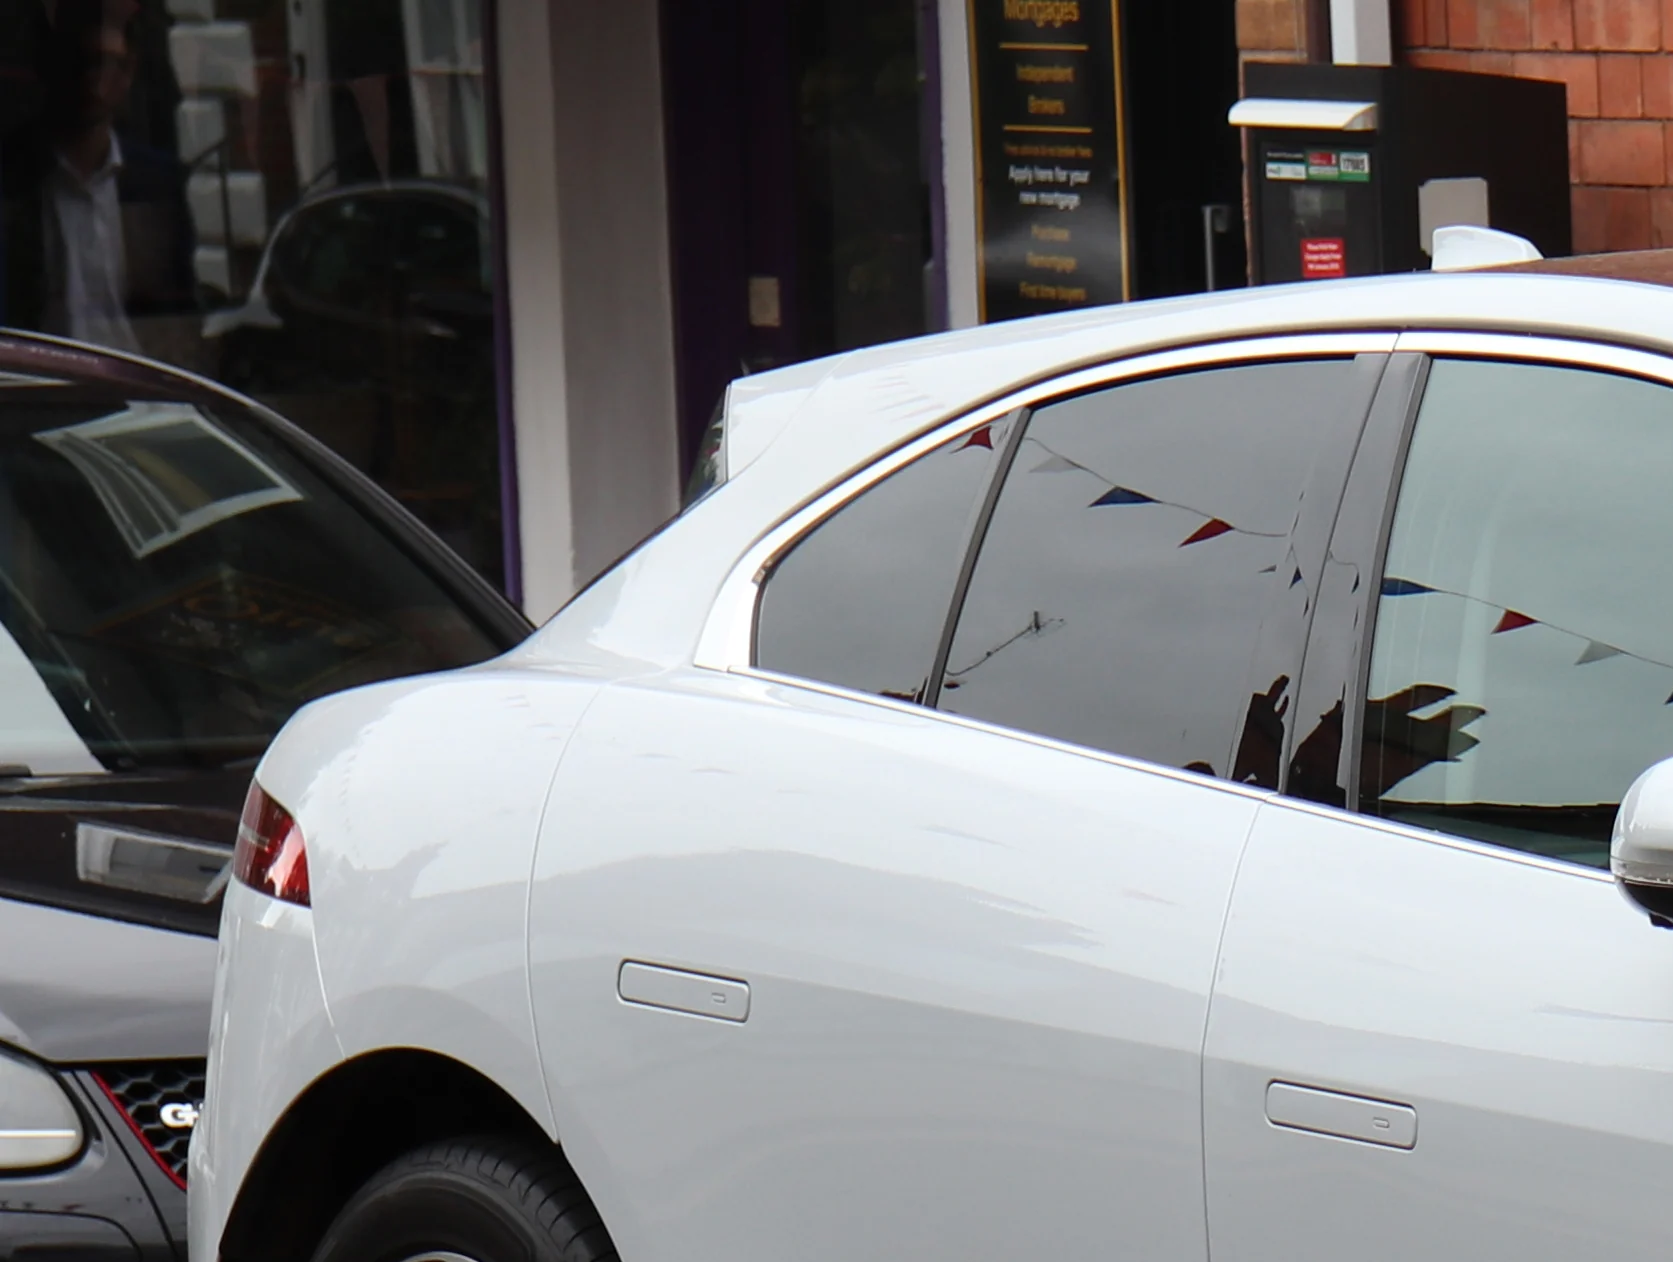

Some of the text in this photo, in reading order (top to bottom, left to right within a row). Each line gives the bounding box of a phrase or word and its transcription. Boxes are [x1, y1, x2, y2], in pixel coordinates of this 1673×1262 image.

[1003, 0, 1080, 27] Mortgages
[1008, 164, 1033, 185] Apply
[1069, 170, 1091, 187] your
[1038, 191, 1081, 210] mortgage
